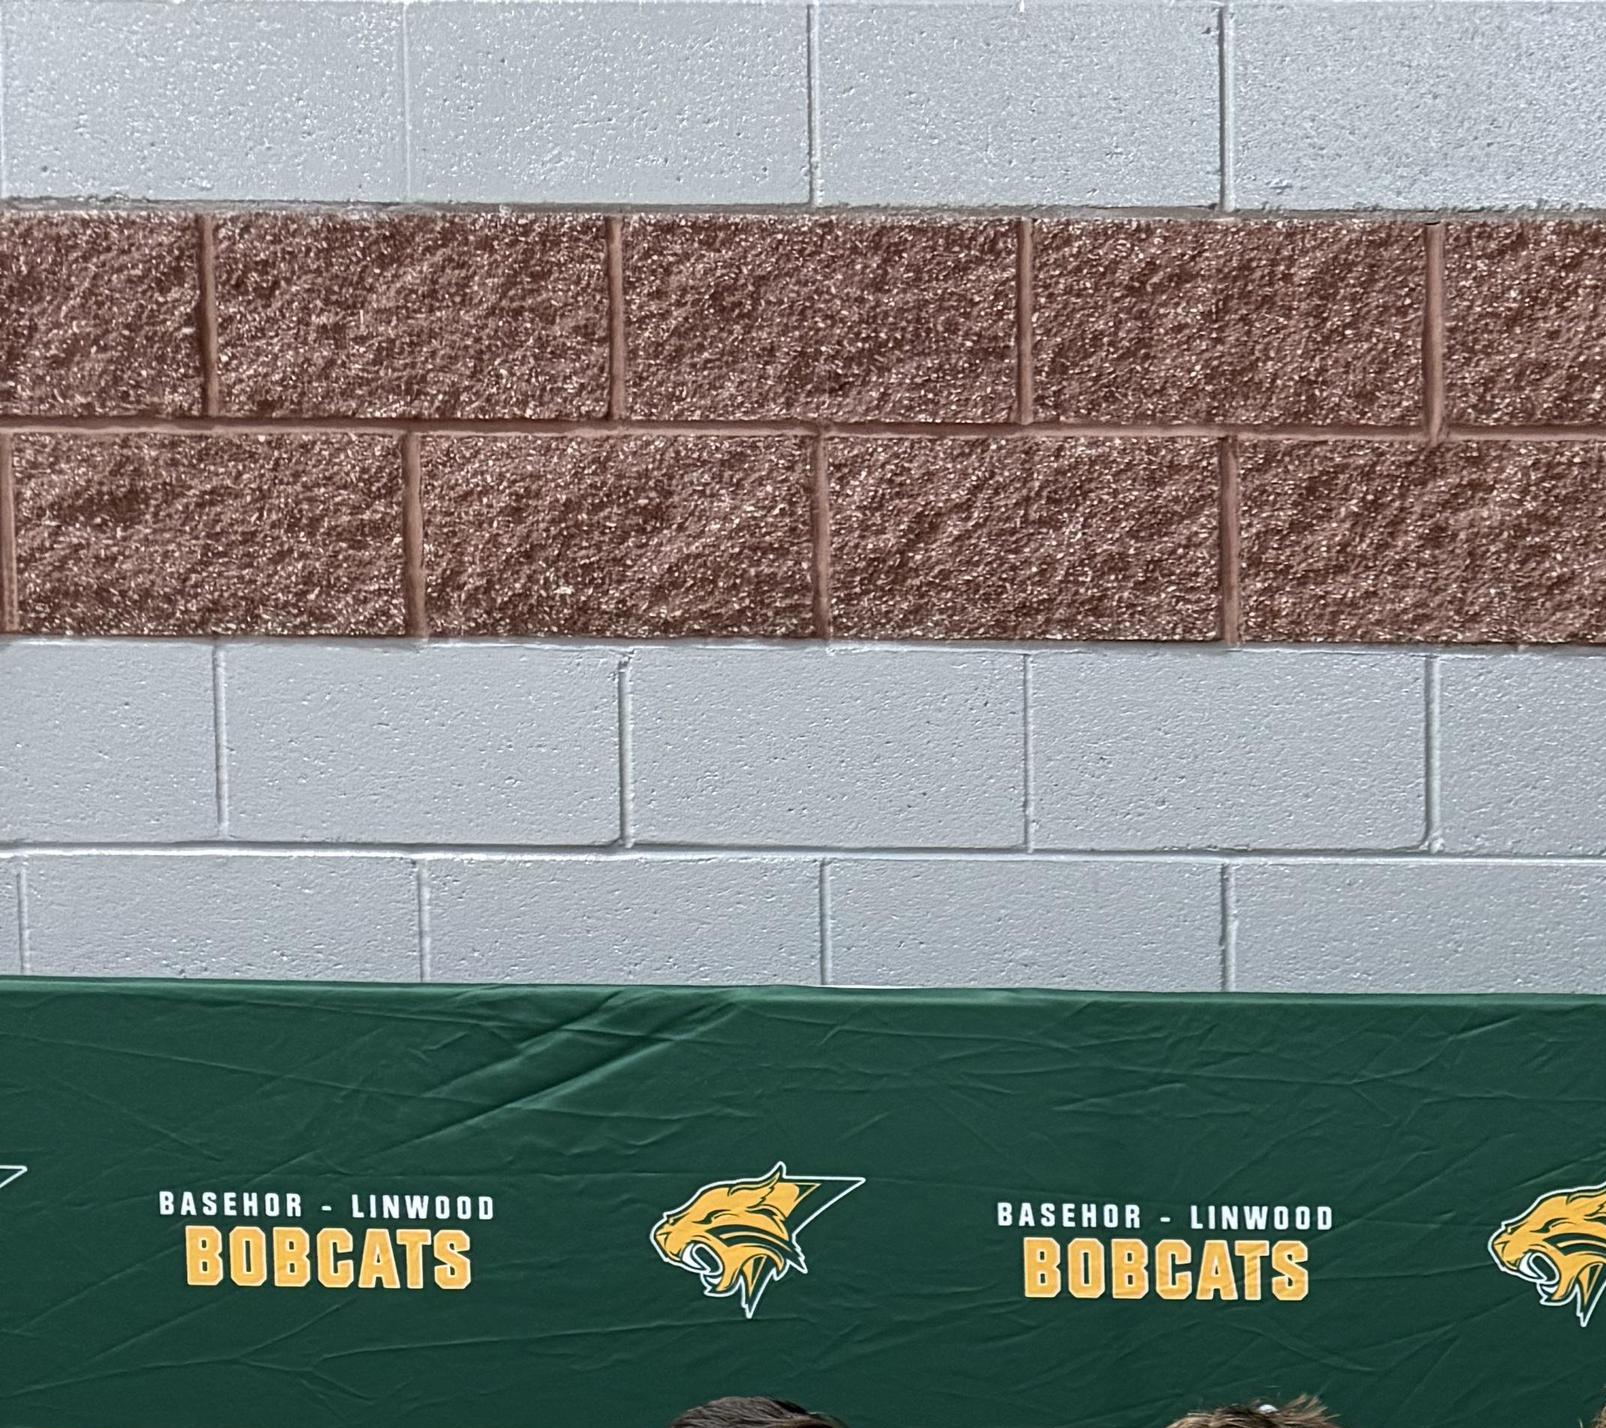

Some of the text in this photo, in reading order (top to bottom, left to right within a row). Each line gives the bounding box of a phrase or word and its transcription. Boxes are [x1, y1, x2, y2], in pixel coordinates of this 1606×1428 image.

[159, 1190, 303, 1217] BASEHOR
[351, 1193, 495, 1220] LINWOOD
[996, 1201, 1141, 1229] BASEHOR
[1190, 1204, 1334, 1231] LINWOOD
[184, 1224, 472, 1290] BOBCATS
[1022, 1236, 1310, 1302] BOBCATS
